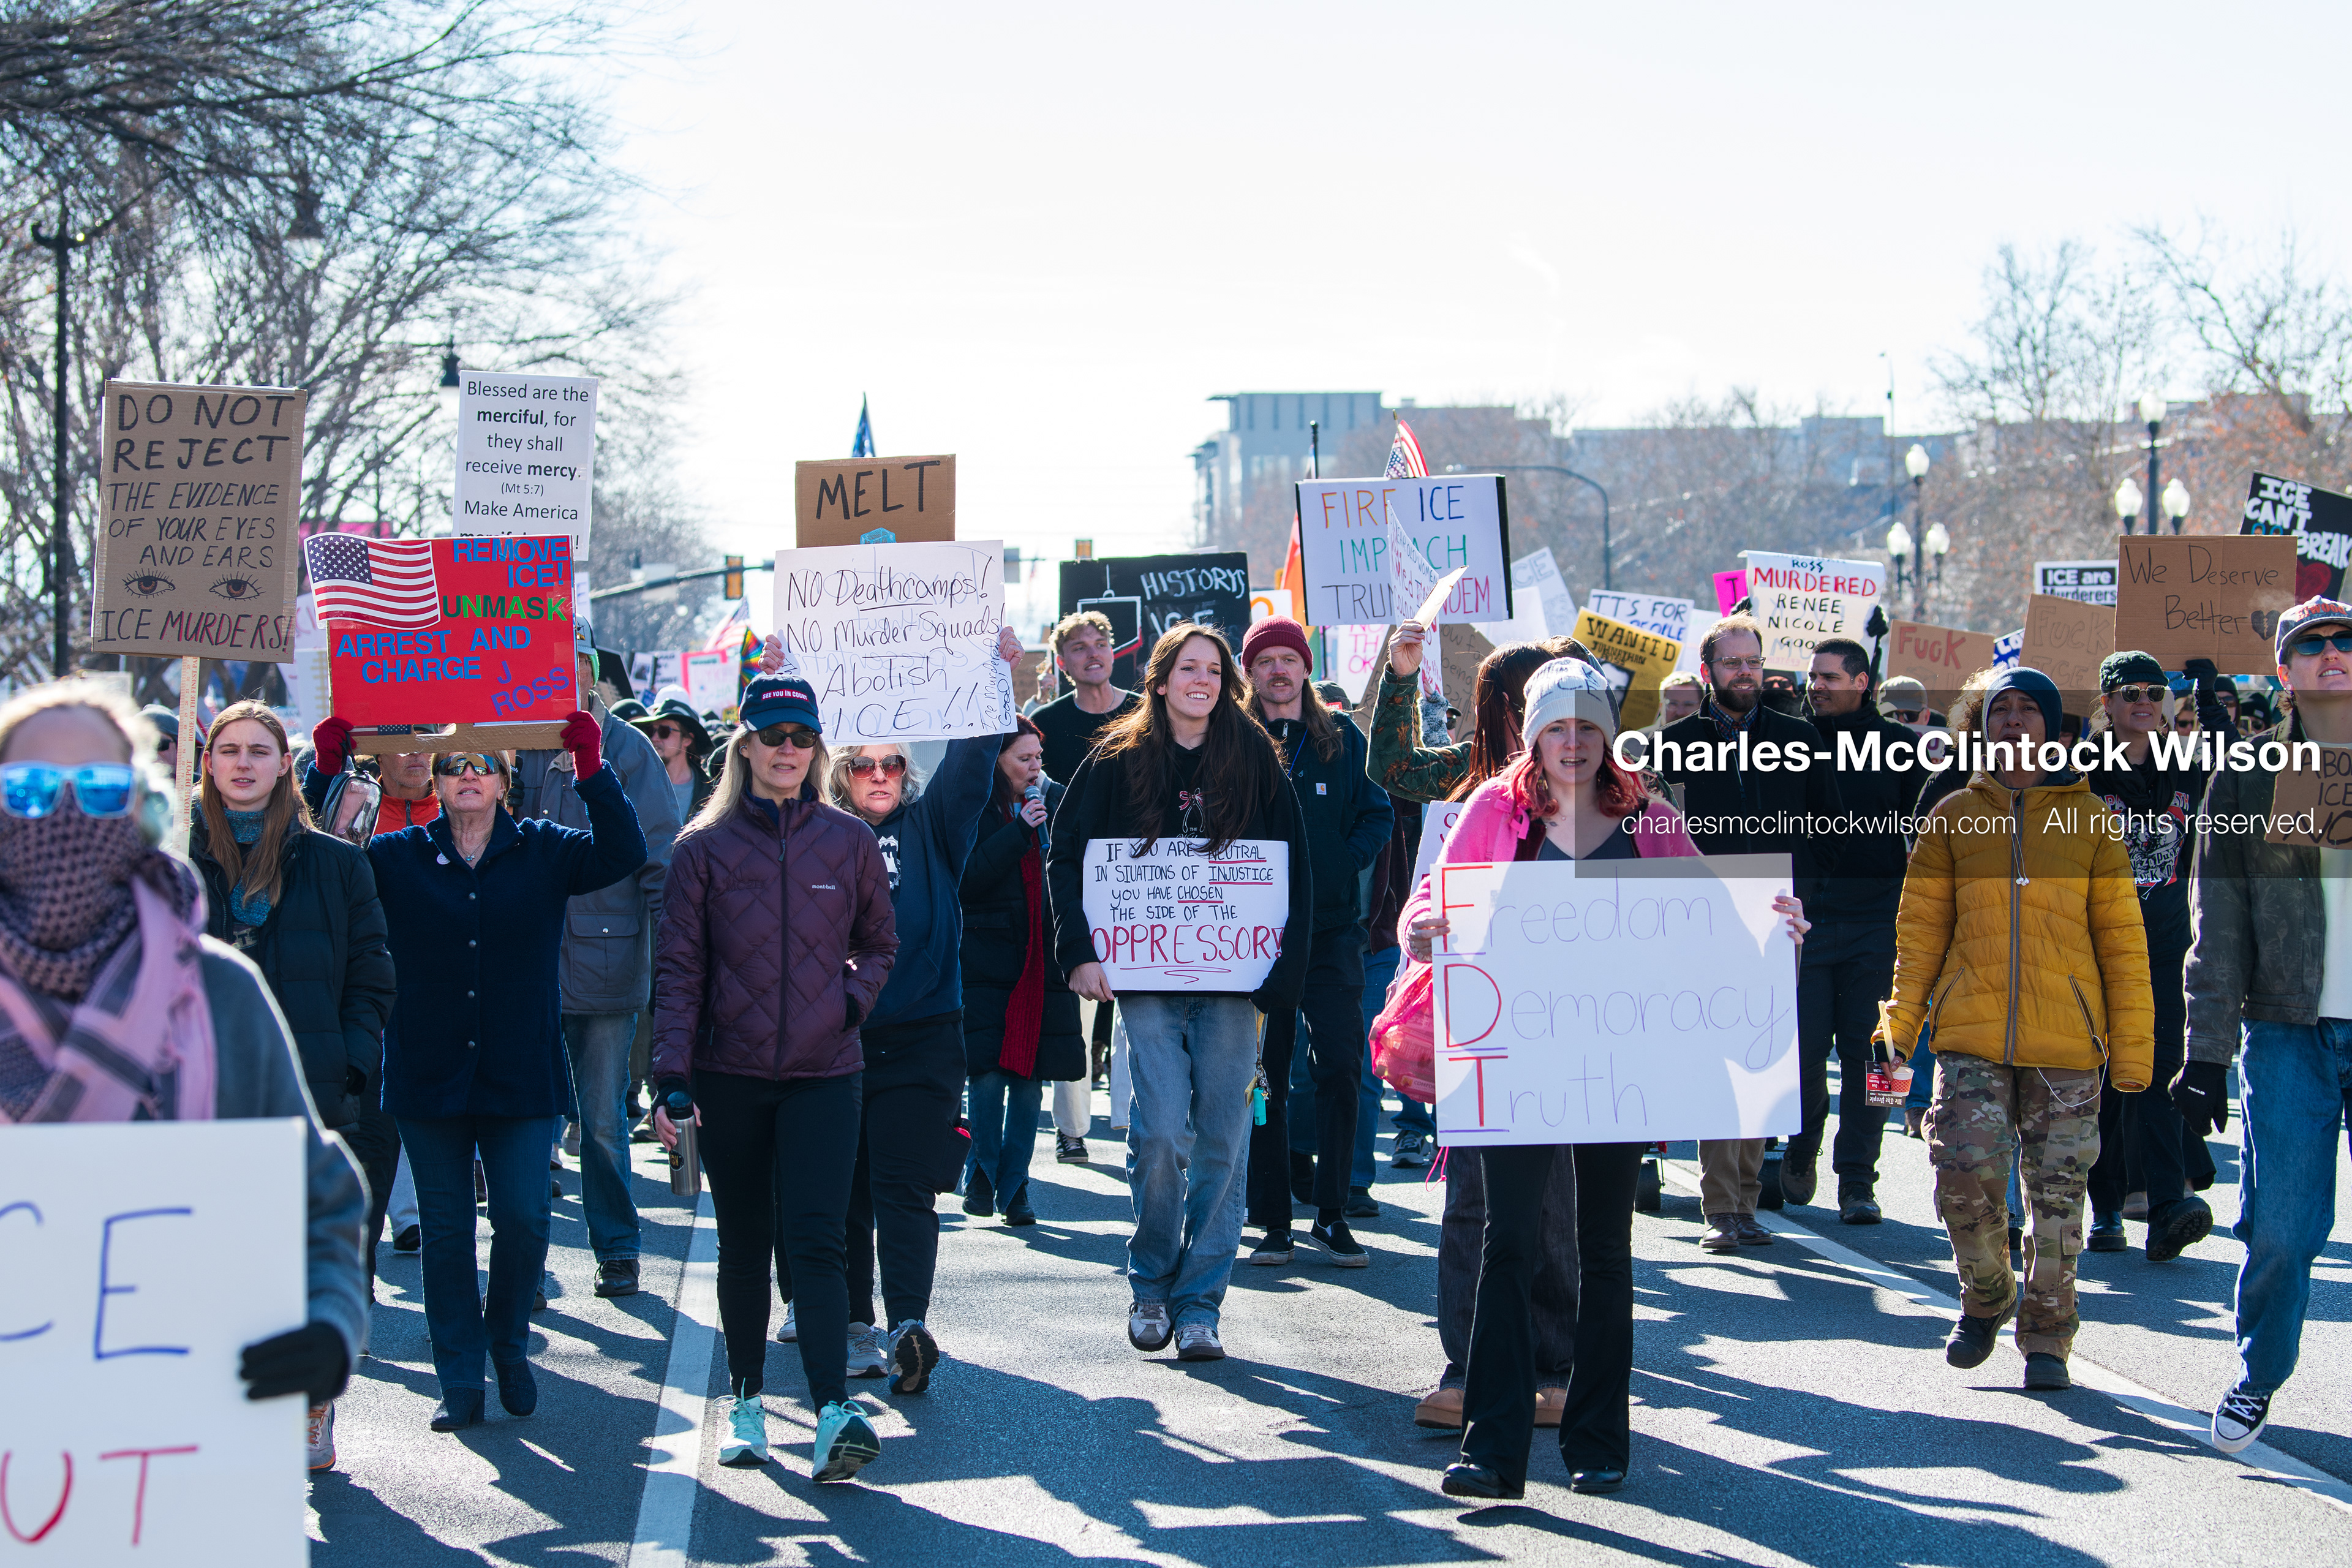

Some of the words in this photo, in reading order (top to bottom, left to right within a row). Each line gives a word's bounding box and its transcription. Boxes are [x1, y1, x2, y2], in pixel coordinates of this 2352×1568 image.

[467, 380, 527, 398] Blessed
[532, 388, 557, 400] are
[563, 386, 589, 402] the
[118, 394, 173, 431] DO
[194, 393, 296, 429] NOT
[477, 409, 548, 428] merciful,
[554, 410, 576, 427] for
[113, 435, 290, 473] REJECT
[487, 433, 522, 452] they
[527, 435, 563, 451] shall
[466, 459, 522, 475] receive
[527, 464, 581, 481] mercy.
[106, 481, 160, 512] THE
[168, 481, 279, 510] EVIDENCE
[501, 482, 521, 495] (Mt
[523, 484, 545, 497] 5:7)
[816, 460, 941, 520] MELT
[2258, 476, 2312, 510] ICE
[464, 500, 508, 516] Make
[513, 503, 578, 520] America
[1419, 486, 1465, 522] ICE
[2245, 497, 2313, 531] CAN'T
[108, 518, 145, 538] OF
[157, 516, 206, 541] YOUR
[216, 517, 275, 541] EYES
[139, 545, 194, 567] AND
[202, 545, 274, 569] EARS
[453, 538, 568, 563] REMOVE
[508, 562, 564, 588] ICE!
[2046, 569, 2078, 585] ICE
[2081, 571, 2112, 585] are
[2125, 545, 2167, 584] We
[2188, 542, 2278, 586] Deserve
[787, 570, 823, 611] NO
[1754, 567, 1877, 597] MURDERED
[442, 595, 568, 621] UNMASK
[1651, 601, 1687, 622] FOR
[1776, 593, 1842, 613] RENEE
[2165, 595, 2248, 635] Better
[97, 608, 153, 643] ICE
[159, 610, 293, 653] MURDERS!
[787, 617, 823, 653] NO
[834, 617, 918, 651] Murder
[1768, 616, 1844, 633] NICOLE
[336, 630, 451, 657] ARREST
[470, 626, 531, 651] AND
[1587, 617, 1677, 662] WANTED
[1781, 636, 1815, 649] GOO
[362, 656, 481, 684] CHARGE
[497, 660, 512, 685] J
[491, 666, 570, 716] ROSS
[792, 691, 808, 700] COURT
[189, 710, 195, 720] OF
[1106, 843, 1123, 862] IF
[1167, 840, 1194, 857] ARE
[1095, 865, 1107, 882] IN
[1182, 865, 1199, 881] OF
[1208, 866, 1273, 882] INJUSTICE
[1110, 889, 1140, 909] YOU
[1147, 886, 1172, 900] HAVE
[1177, 886, 1223, 901] CHOSEN
[1441, 865, 1713, 953] Freedom
[1110, 907, 1136, 922] THE
[1146, 905, 1176, 919] SIDE
[1183, 905, 1200, 921] OF
[1208, 905, 1238, 921] THE
[1091, 924, 1284, 964] OPPRESSOR!
[1444, 963, 1792, 1070] Demoracy
[1448, 1051, 1648, 1128] Truth
